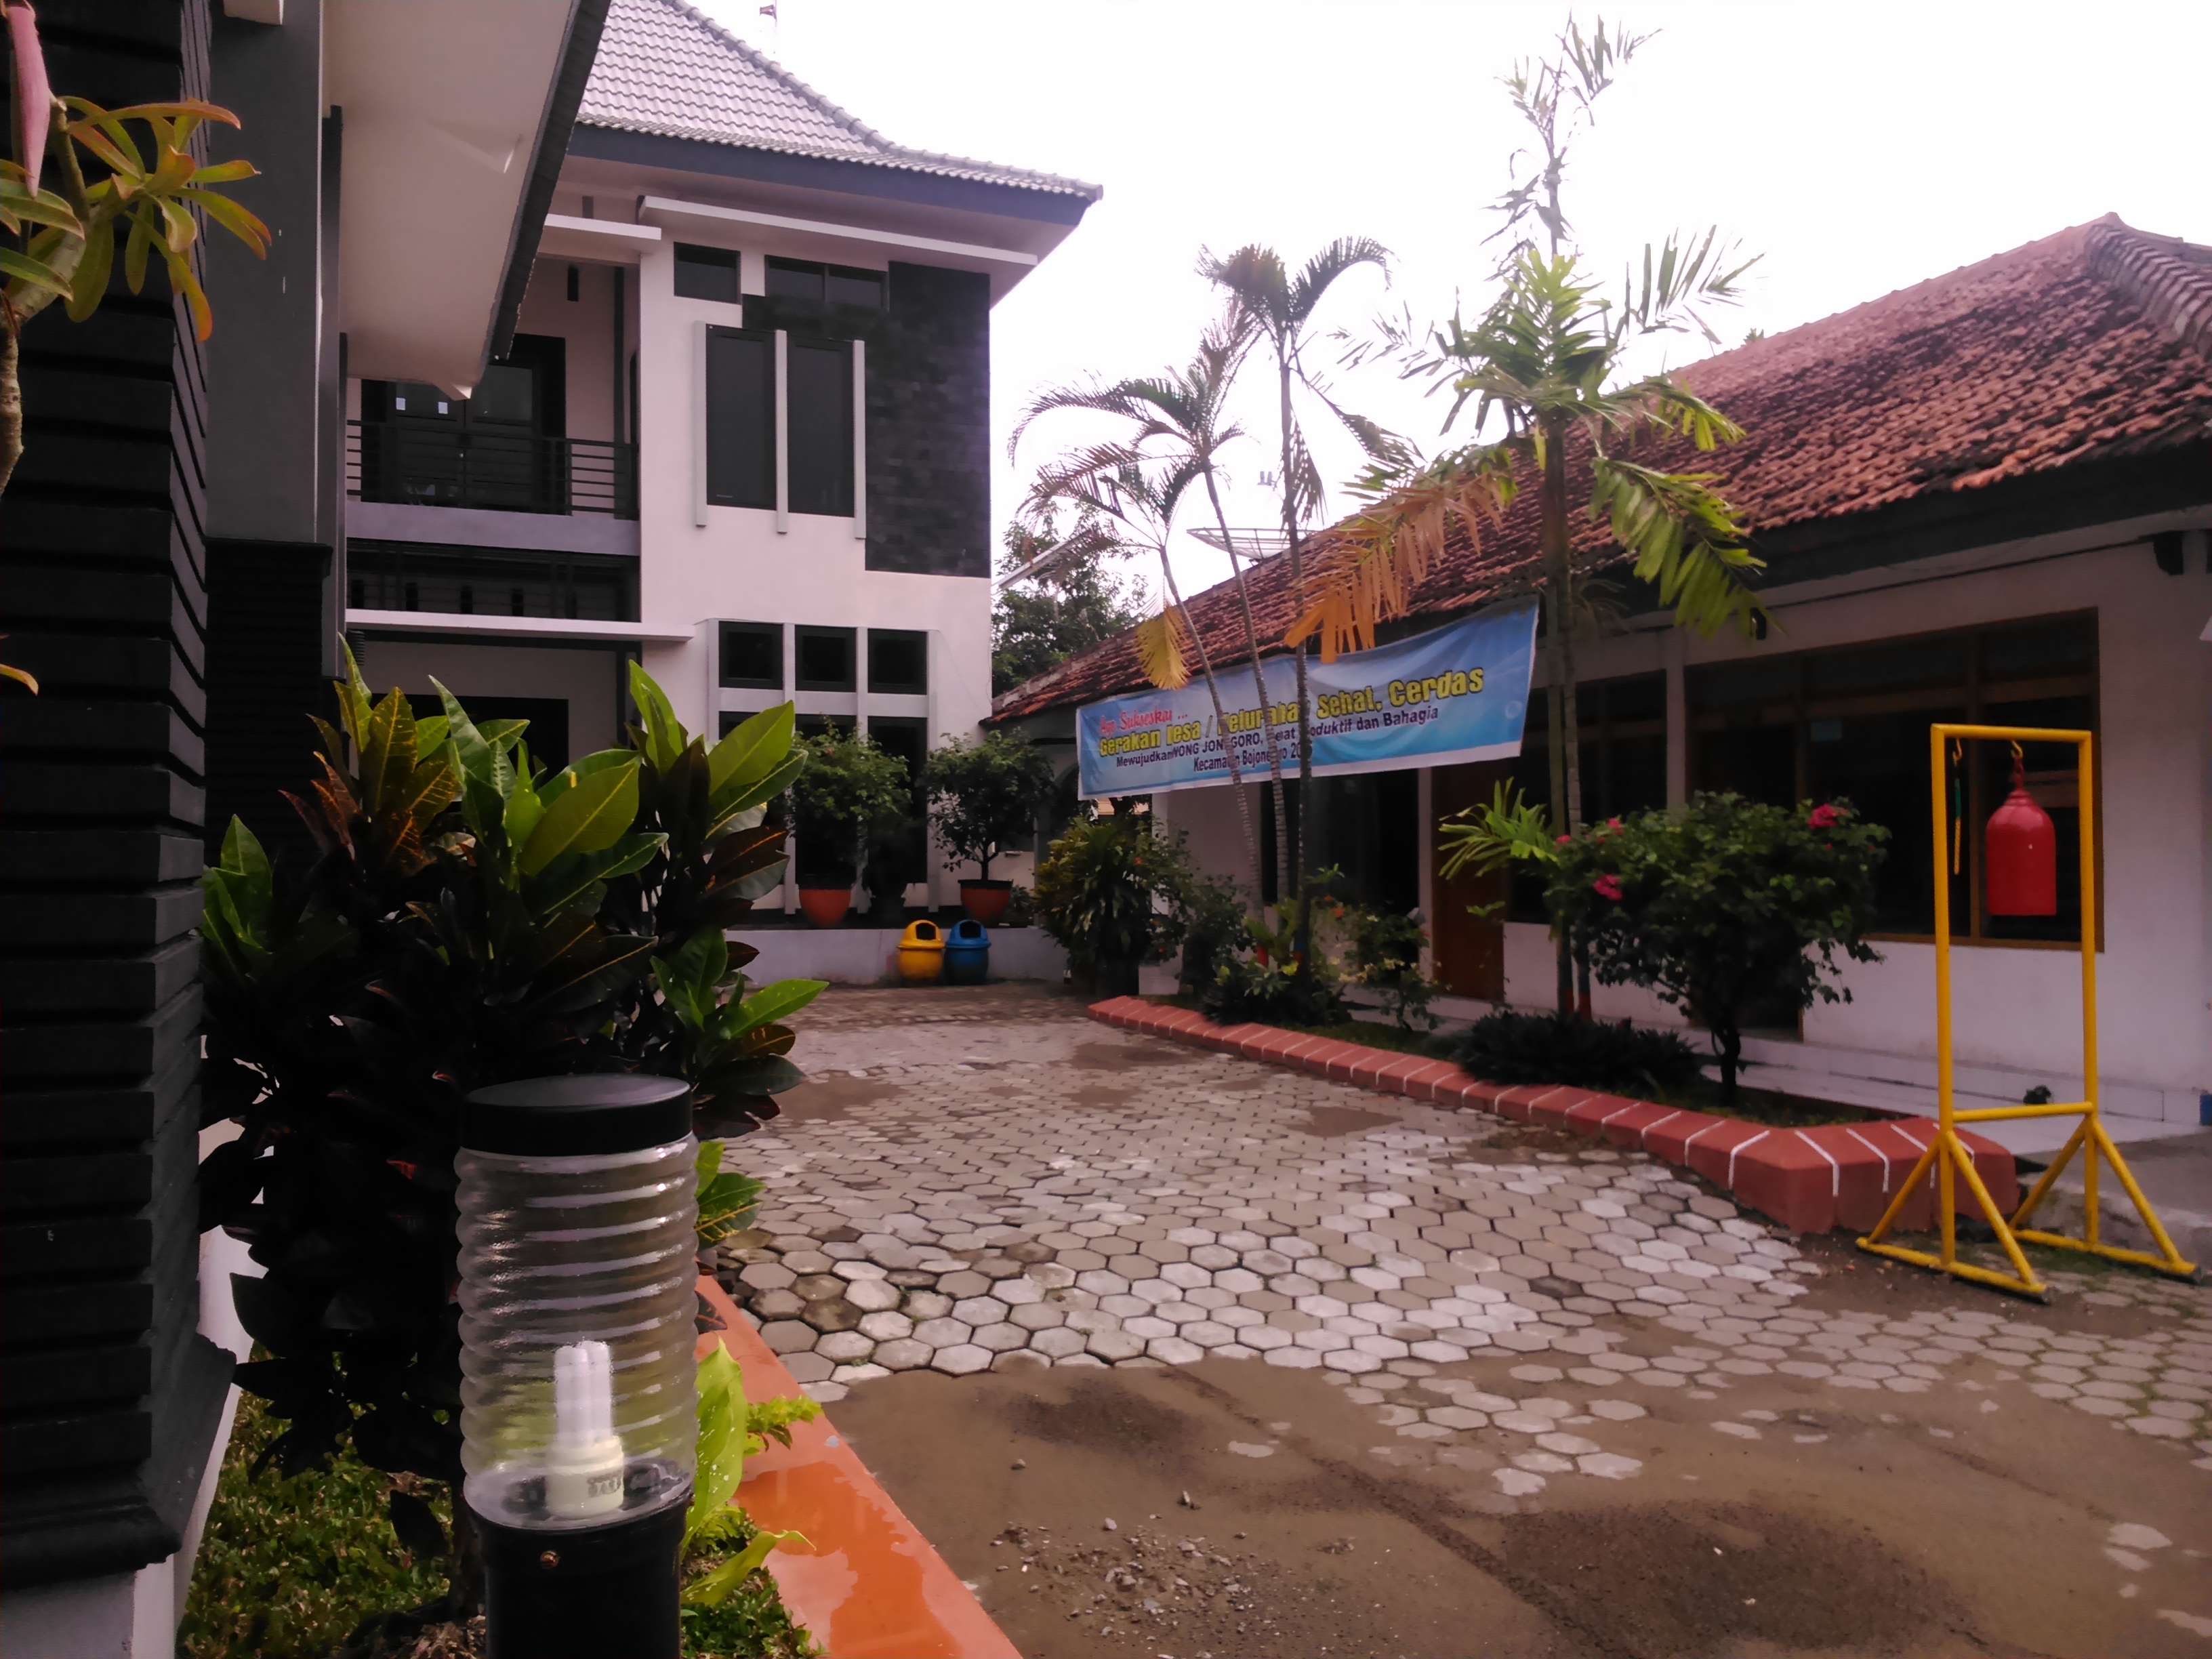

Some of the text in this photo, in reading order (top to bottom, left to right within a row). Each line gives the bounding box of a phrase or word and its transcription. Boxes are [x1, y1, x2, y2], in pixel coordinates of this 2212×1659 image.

[1099, 729, 1161, 757] Gerakan
[1316, 685, 1383, 719] Sehat,
[1387, 667, 1484, 708] Cerdas
[1202, 732, 1263, 753] JONGORO,
[1303, 718, 1353, 737] oduktif
[1356, 716, 1380, 731] dan
[1382, 705, 1439, 726] Bahagia
